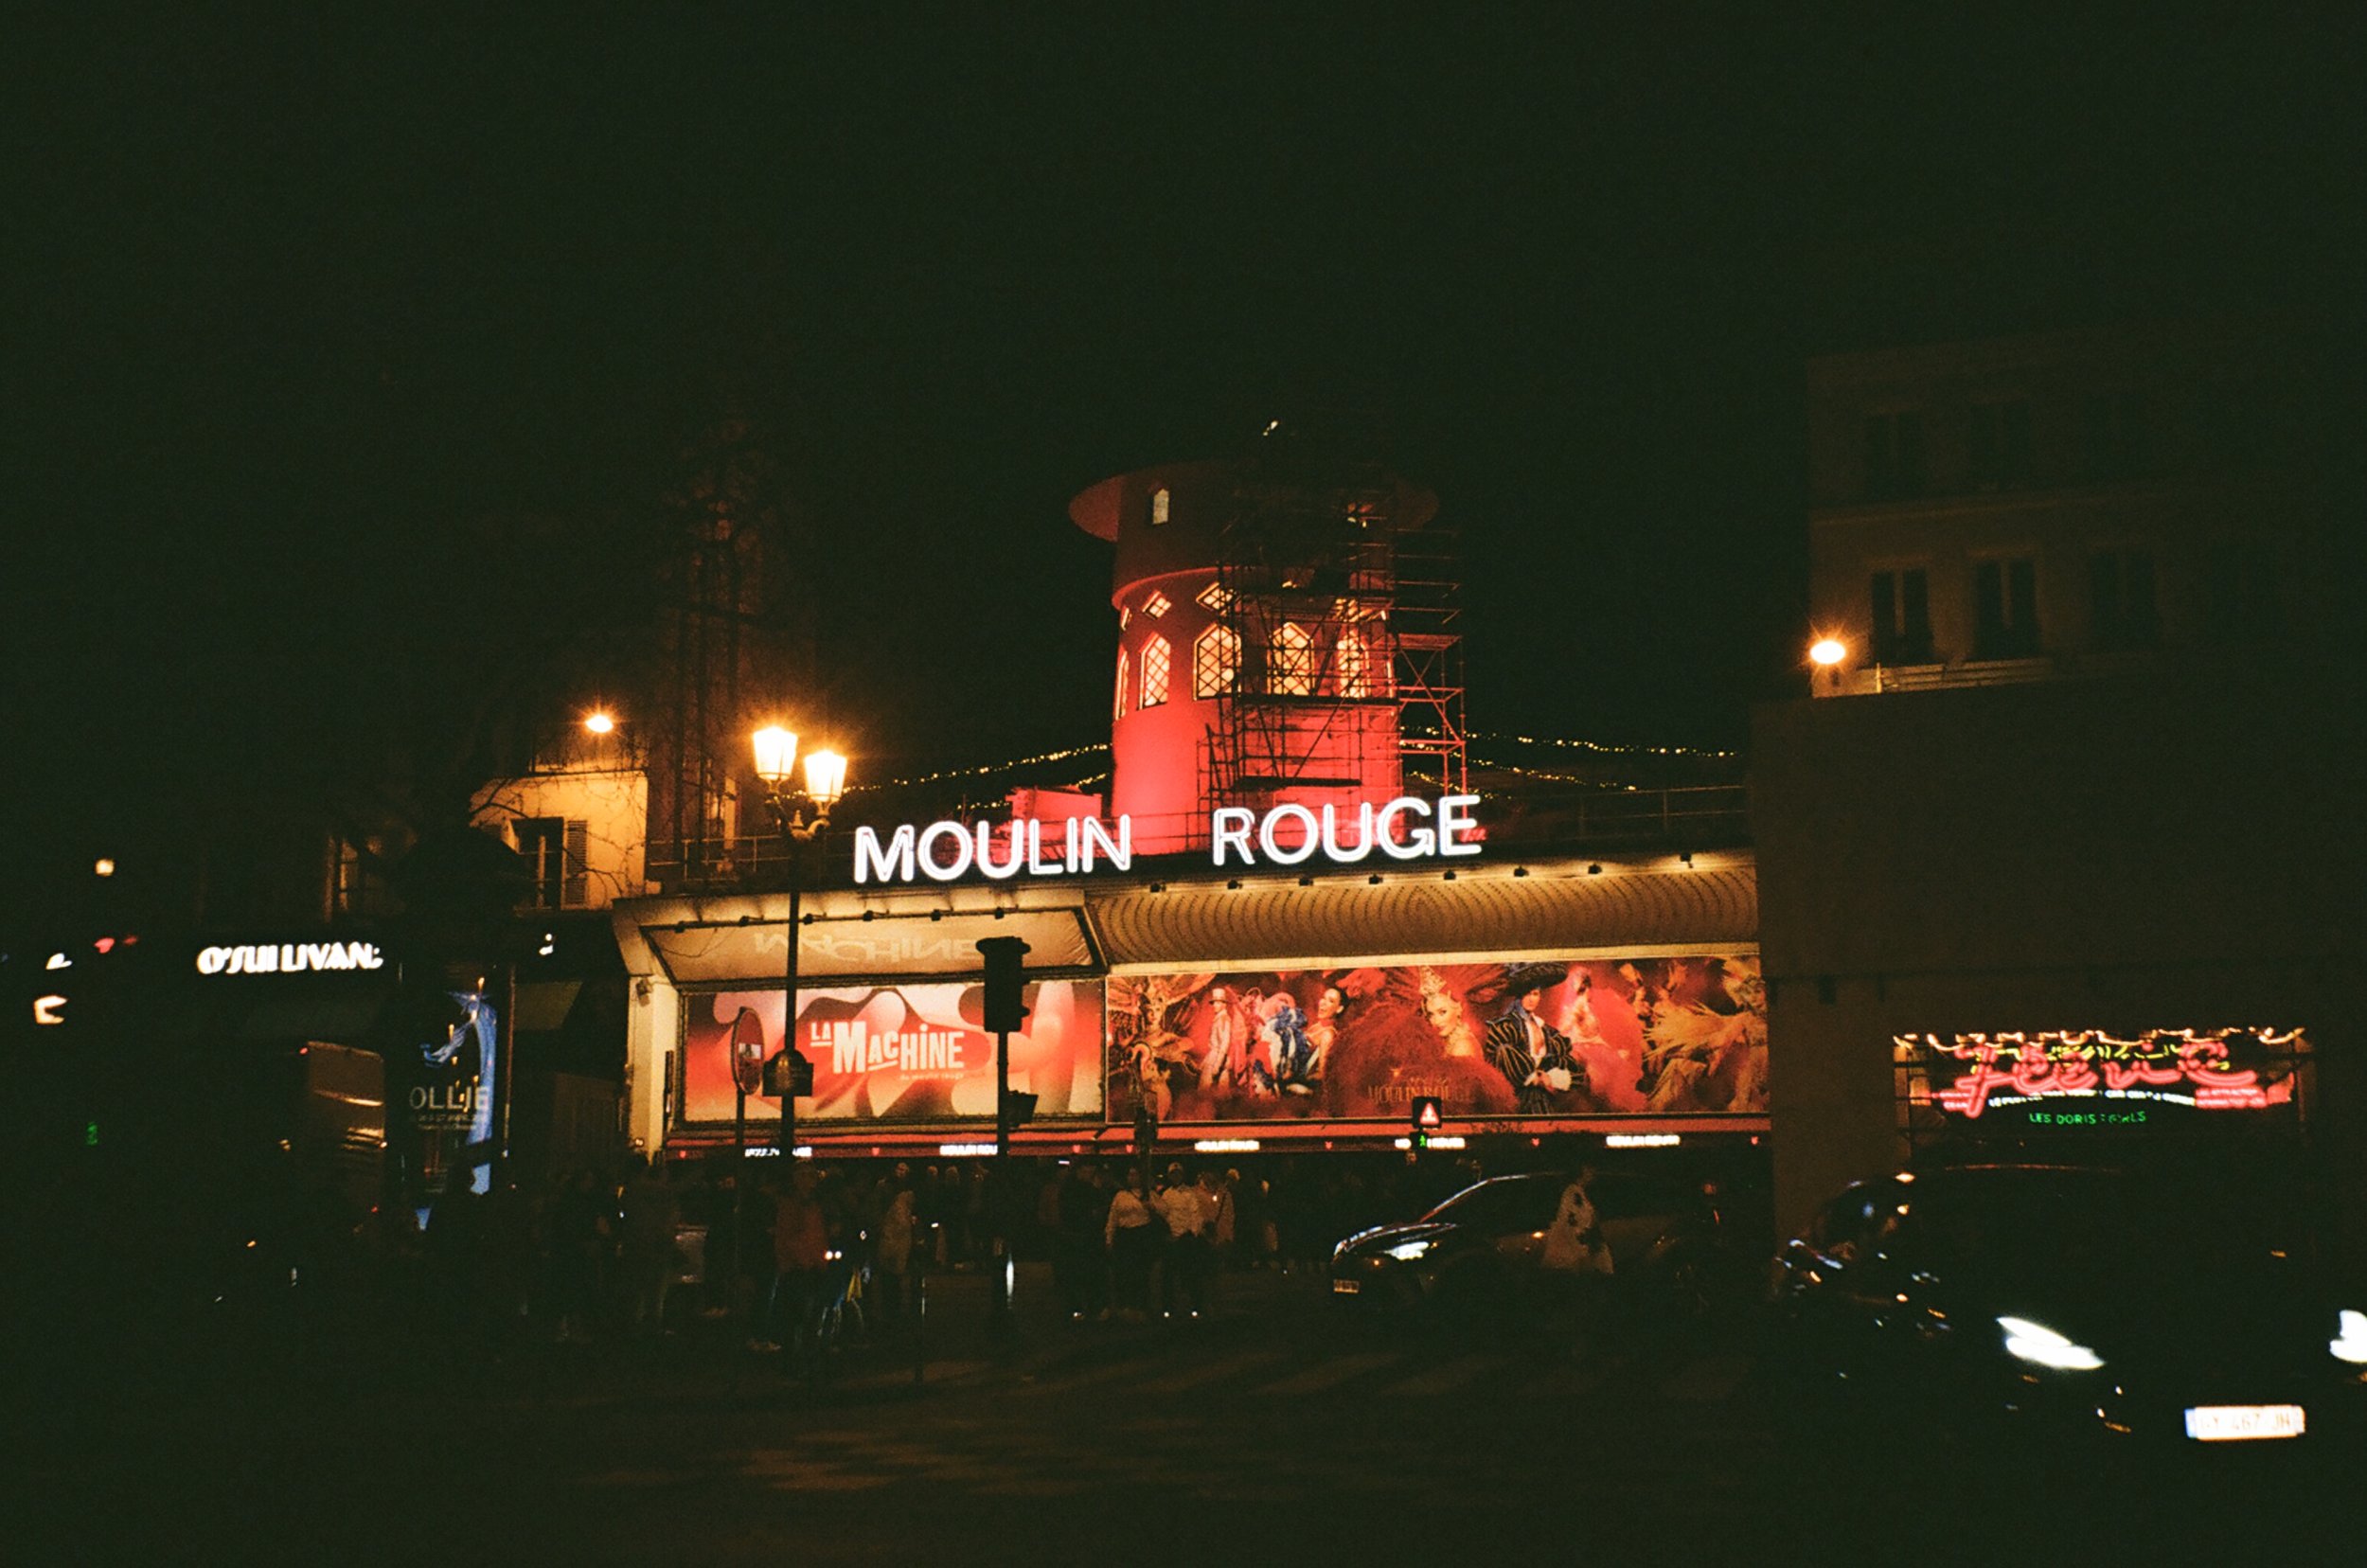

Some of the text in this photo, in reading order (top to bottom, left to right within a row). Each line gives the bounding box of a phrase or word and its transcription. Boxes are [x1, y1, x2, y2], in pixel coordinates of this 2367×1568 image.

[854, 795, 1482, 883] MOULIN ROUGE
[810, 1022, 832, 1041] LA
[2029, 1113, 2052, 1123] LES
[2056, 1114, 2096, 1124] DORIS
